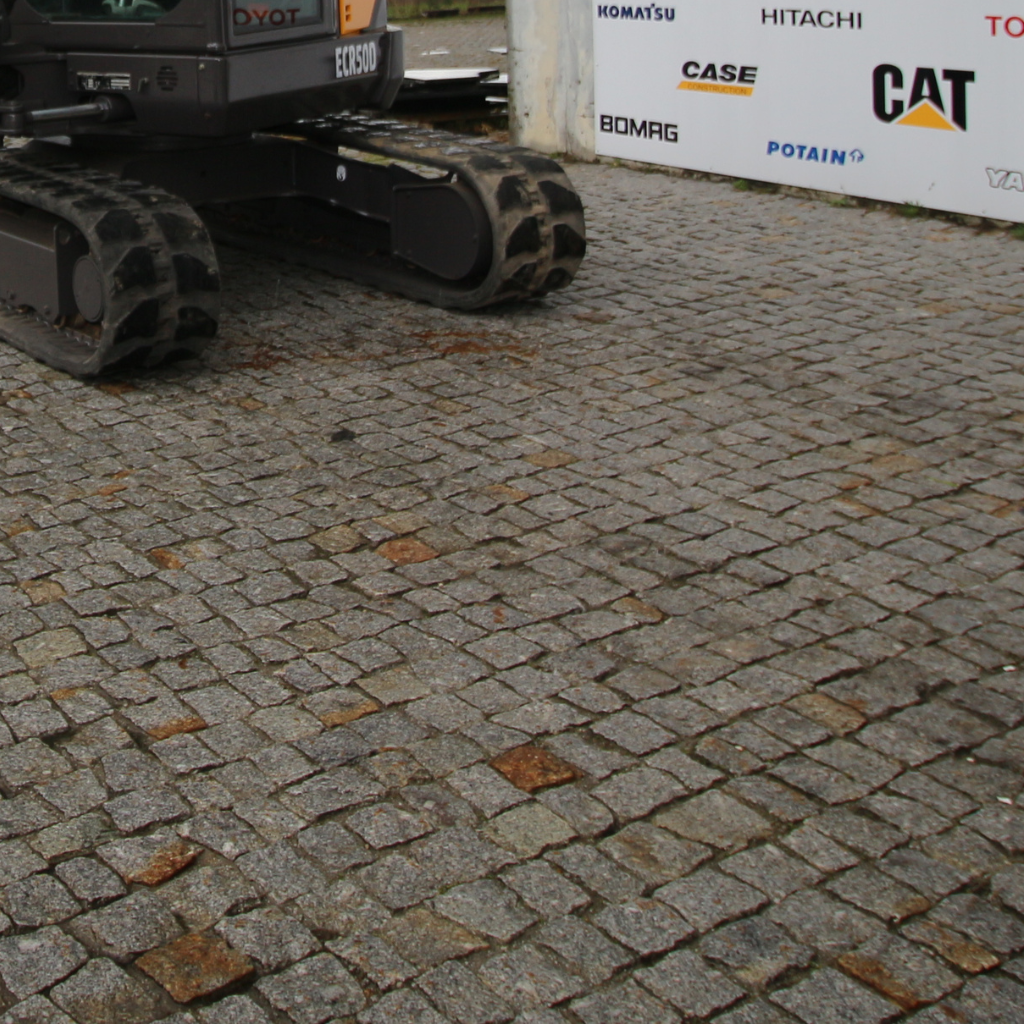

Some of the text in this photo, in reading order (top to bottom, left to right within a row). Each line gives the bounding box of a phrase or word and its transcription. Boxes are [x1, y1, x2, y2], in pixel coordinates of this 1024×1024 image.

[597, 2, 676, 23] KOMATSU
[760, 7, 863, 30] HITACHI
[335, 41, 377, 79] ECR50D
[681, 61, 758, 85] CASE
[687, 82, 747, 96] CONSTRUCTION
[872, 63, 976, 133] CAT
[599, 113, 679, 144] BOMAG
[766, 140, 846, 166] POTAIN
